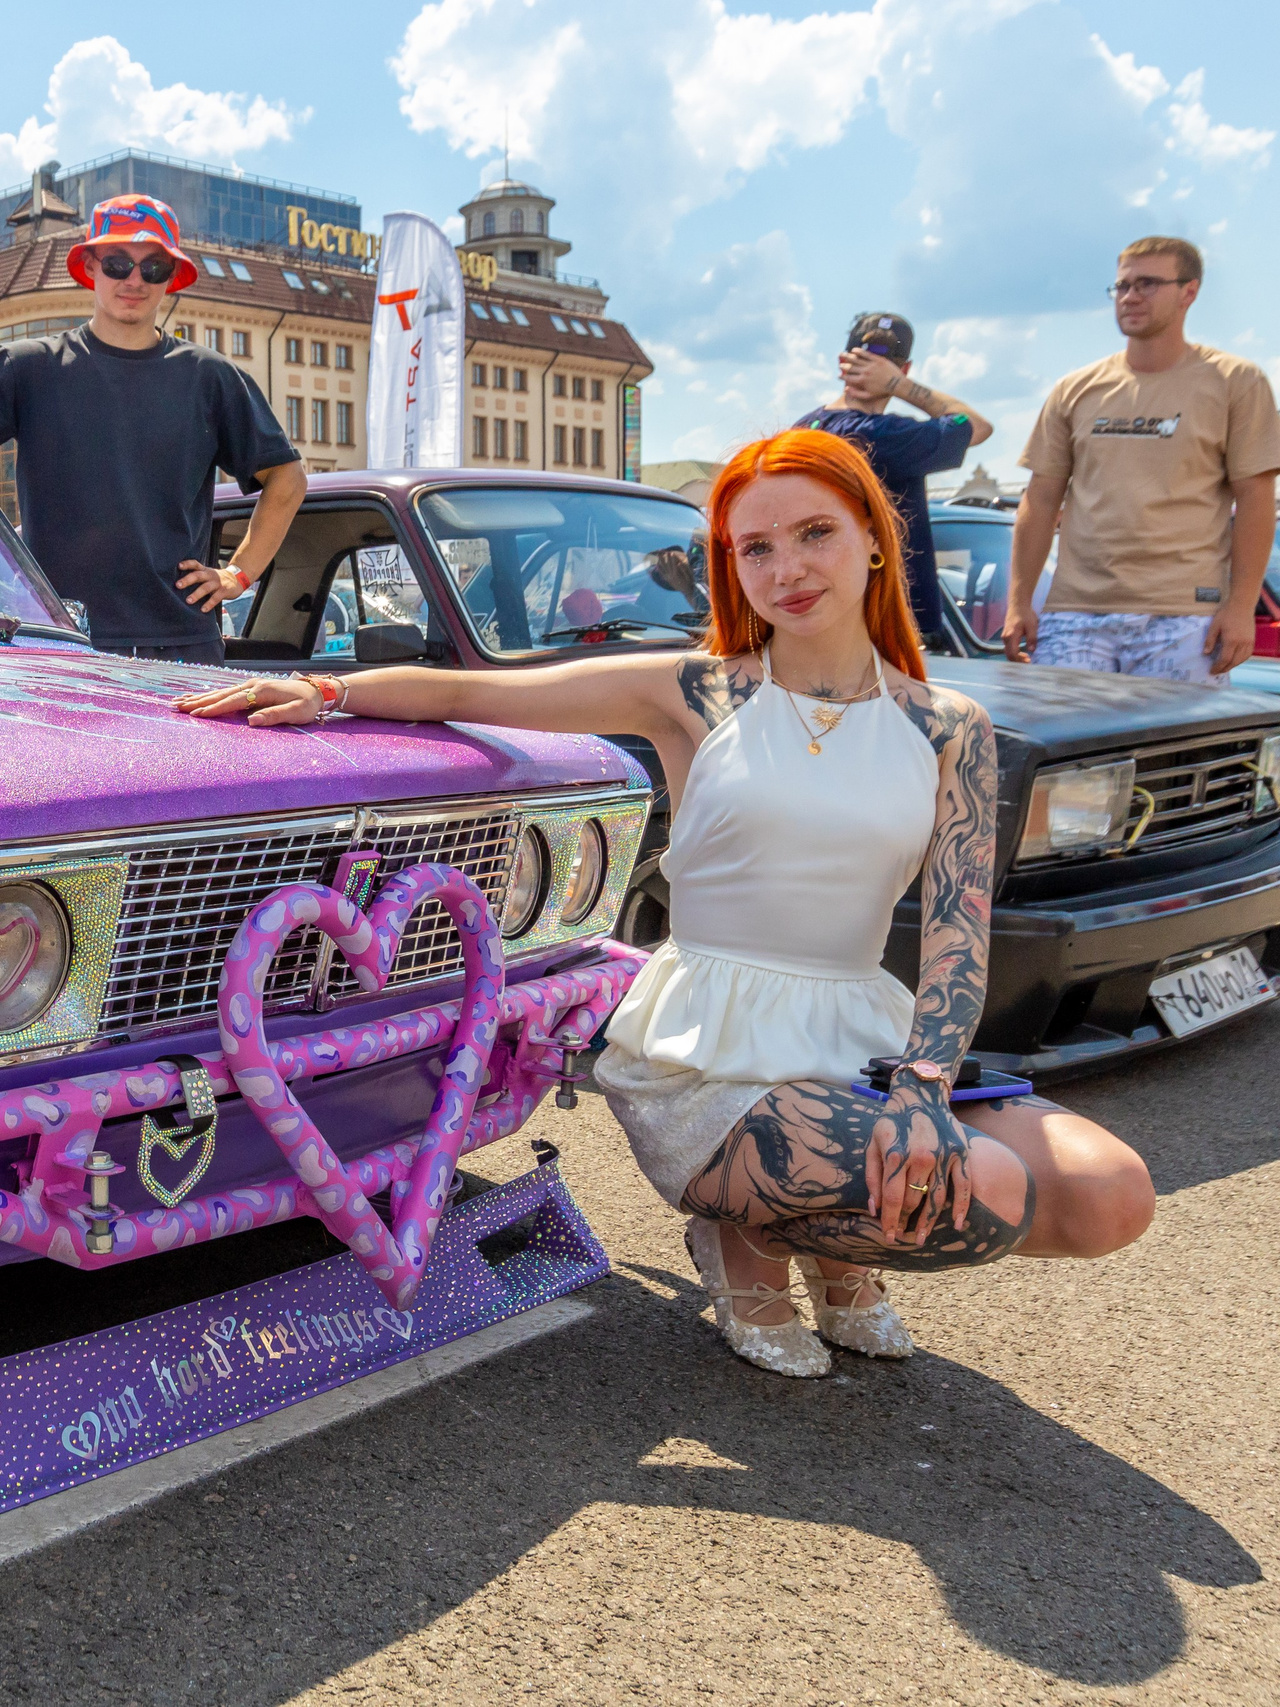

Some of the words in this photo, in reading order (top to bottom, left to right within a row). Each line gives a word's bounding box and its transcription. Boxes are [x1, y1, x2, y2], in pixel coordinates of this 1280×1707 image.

[286, 205, 383, 259] Гостин
[455, 249, 498, 291] вор
[98, 1385, 146, 1443] no
[150, 1330, 234, 1411] hard
[238, 1309, 380, 1364] feelings
